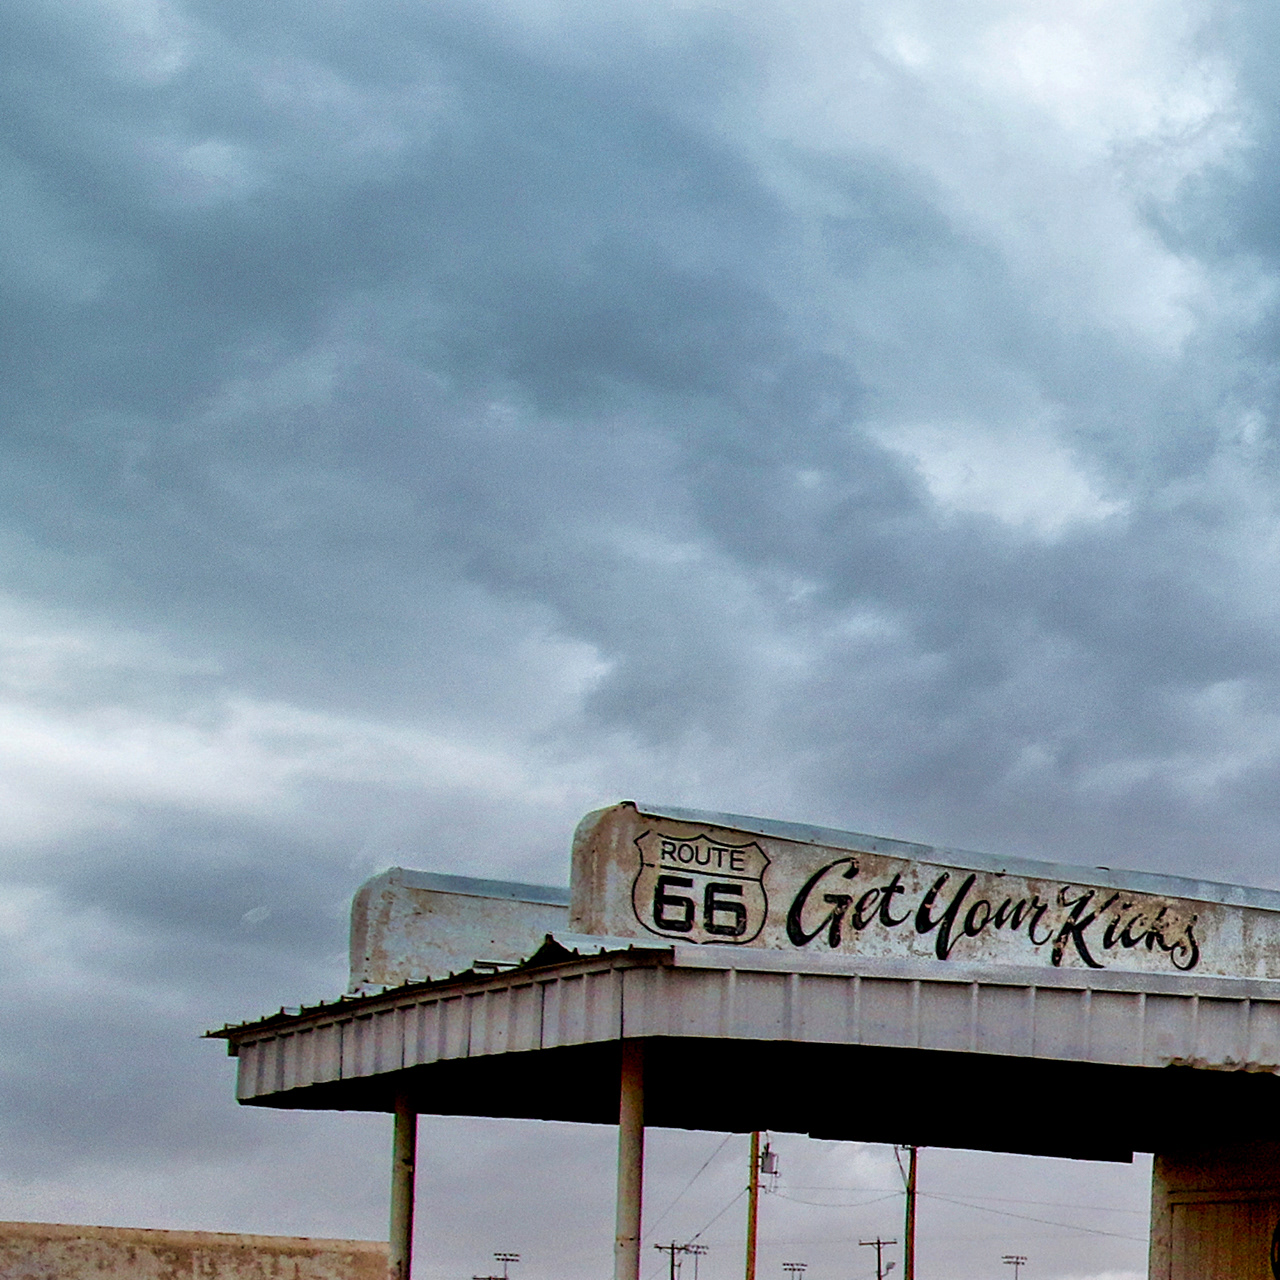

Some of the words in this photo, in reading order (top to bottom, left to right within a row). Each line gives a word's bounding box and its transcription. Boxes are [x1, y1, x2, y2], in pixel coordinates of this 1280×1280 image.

[661, 840, 746, 871] ROUTE
[653, 874, 747, 937] 66
[786, 857, 912, 949] Get
[914, 872, 1053, 961] Your
[1052, 885, 1201, 971] Kicks
